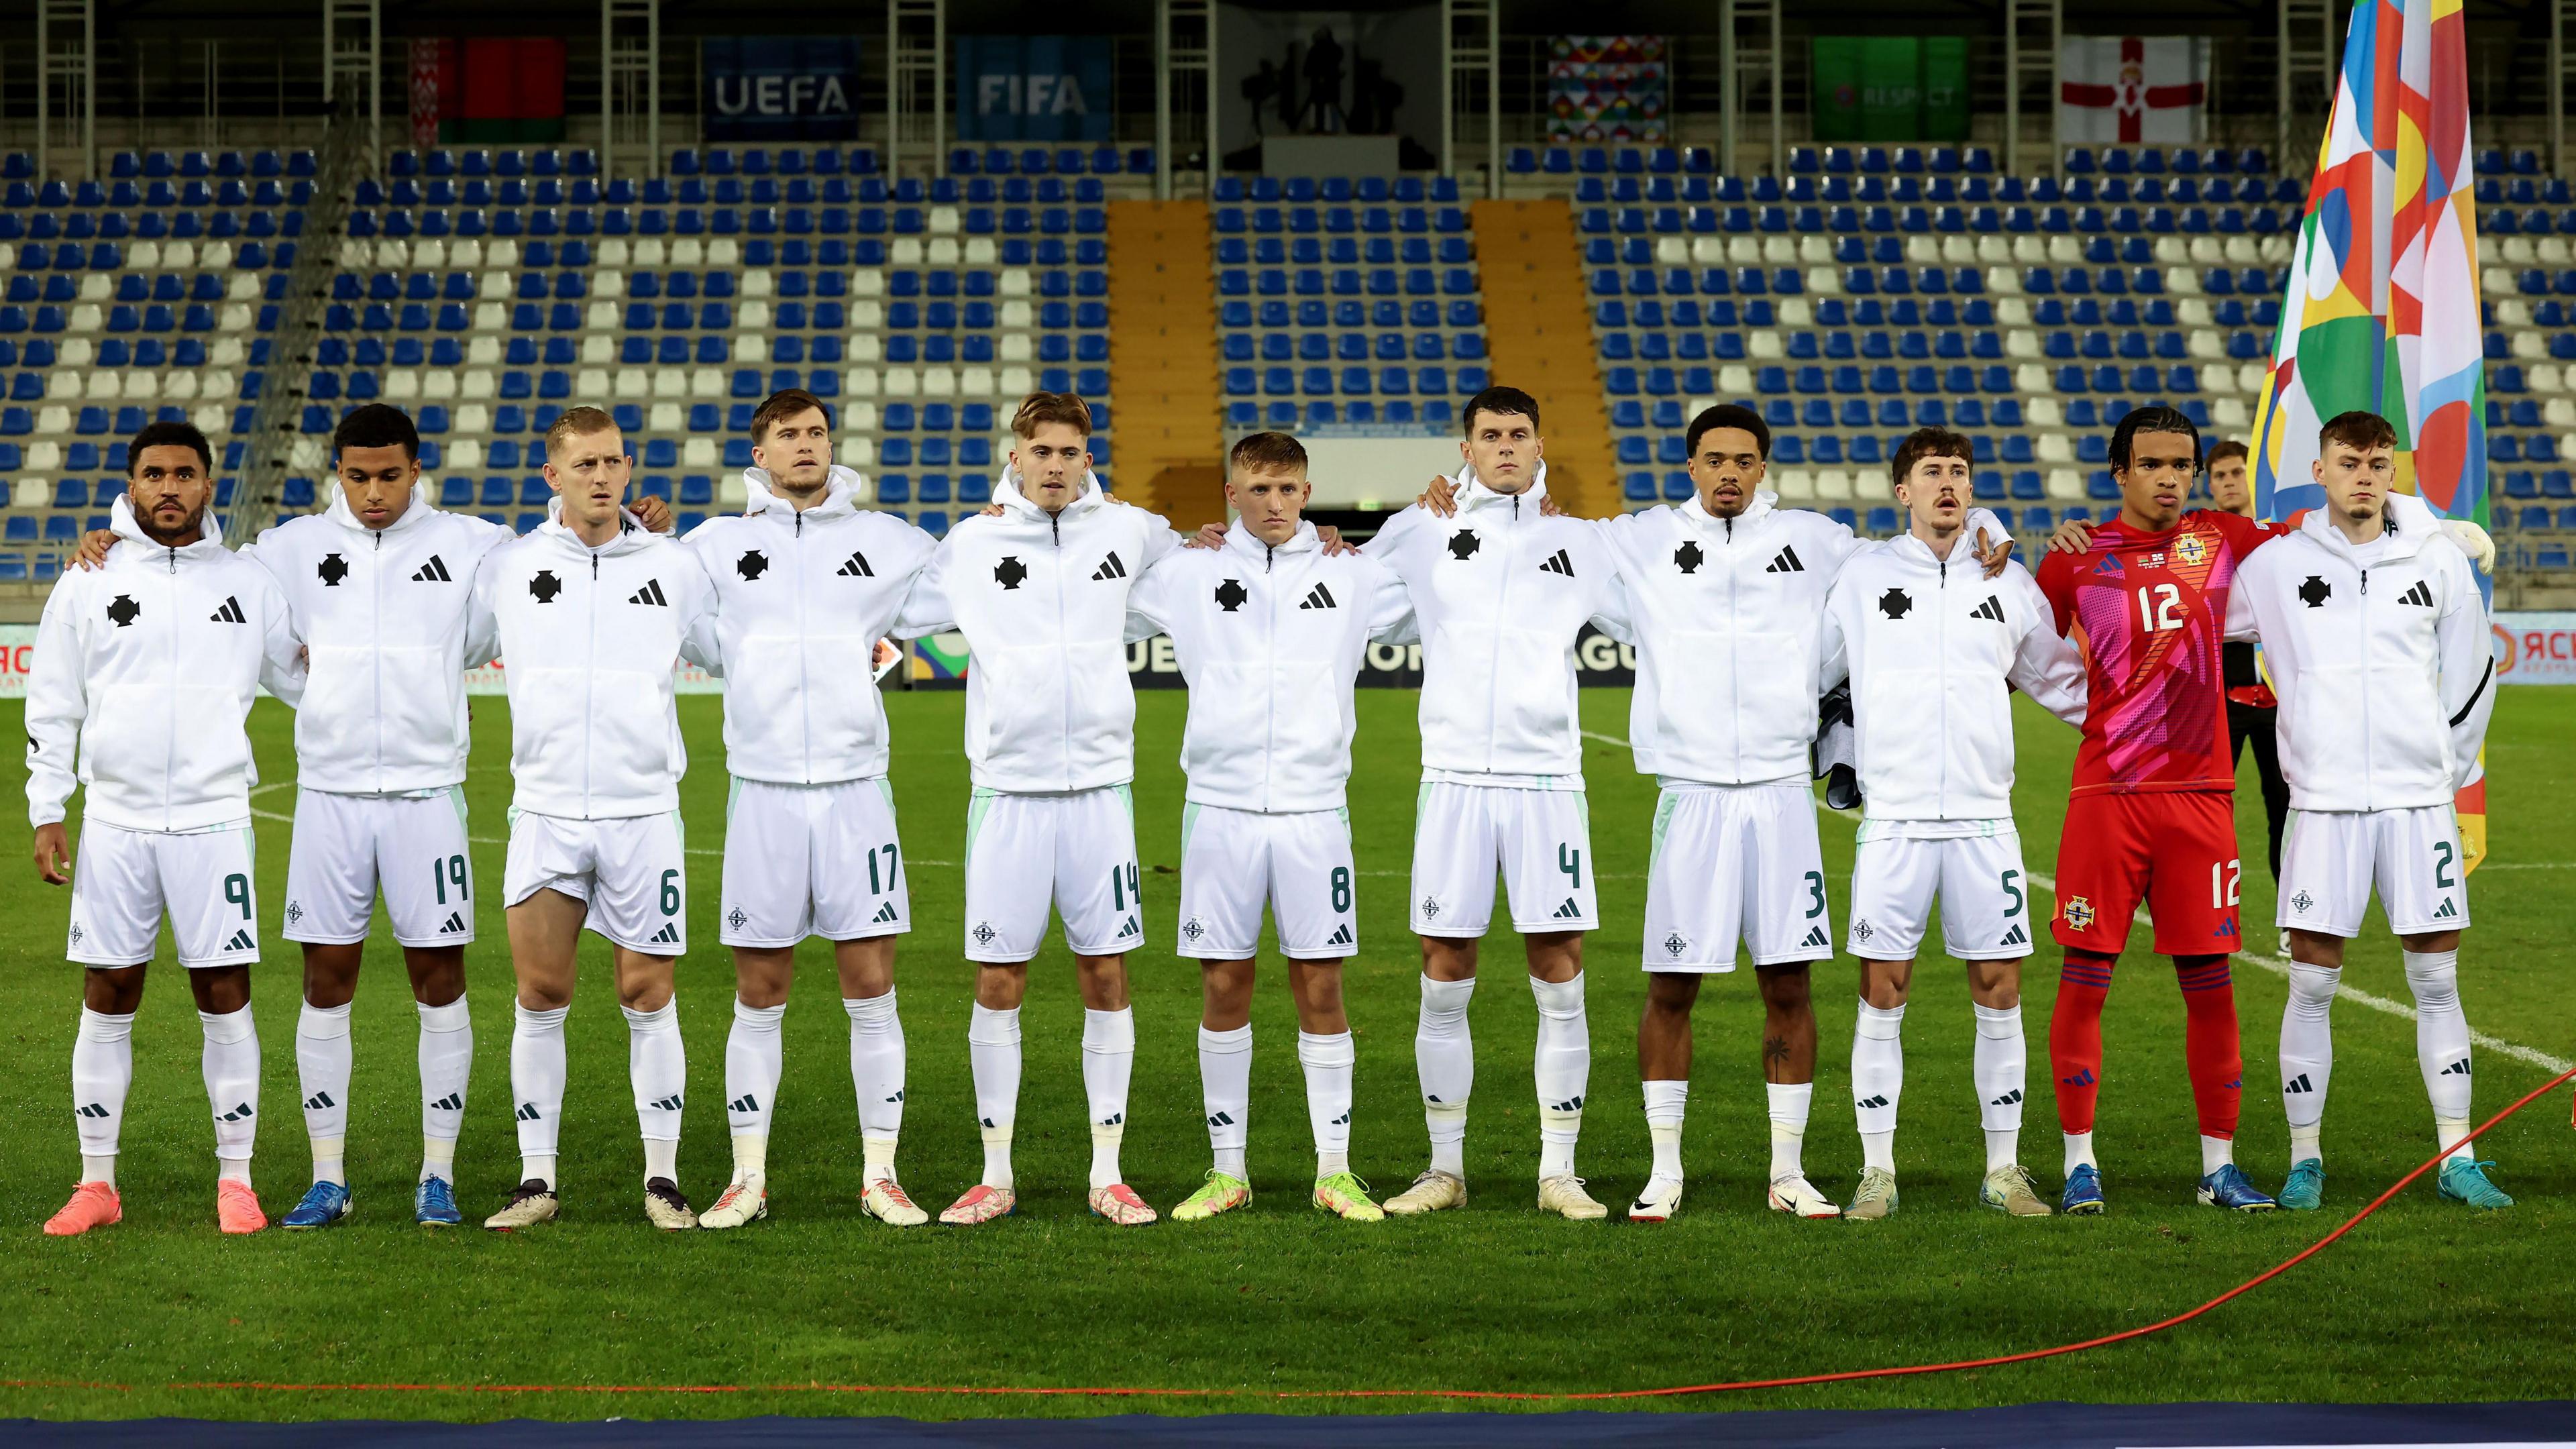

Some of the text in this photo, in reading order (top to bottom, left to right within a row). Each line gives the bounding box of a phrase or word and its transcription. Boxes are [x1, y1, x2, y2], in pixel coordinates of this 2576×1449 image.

[716, 75, 849, 115] UEFA
[978, 75, 1087, 115] FIFA
[1863, 87, 1953, 107] RESPCT
[2138, 583, 2184, 632] 12
[434, 854, 468, 905] 19
[868, 843, 898, 895] 17
[1113, 861, 1140, 912] 14
[1558, 842, 1580, 889] 4
[2212, 859, 2241, 909] 12
[2434, 841, 2455, 889] 2
[225, 873, 252, 920] 9
[659, 869, 680, 916] 6
[1331, 866, 1351, 914] 8
[1805, 871, 1825, 919] 3
[2001, 869, 2023, 918] 5
